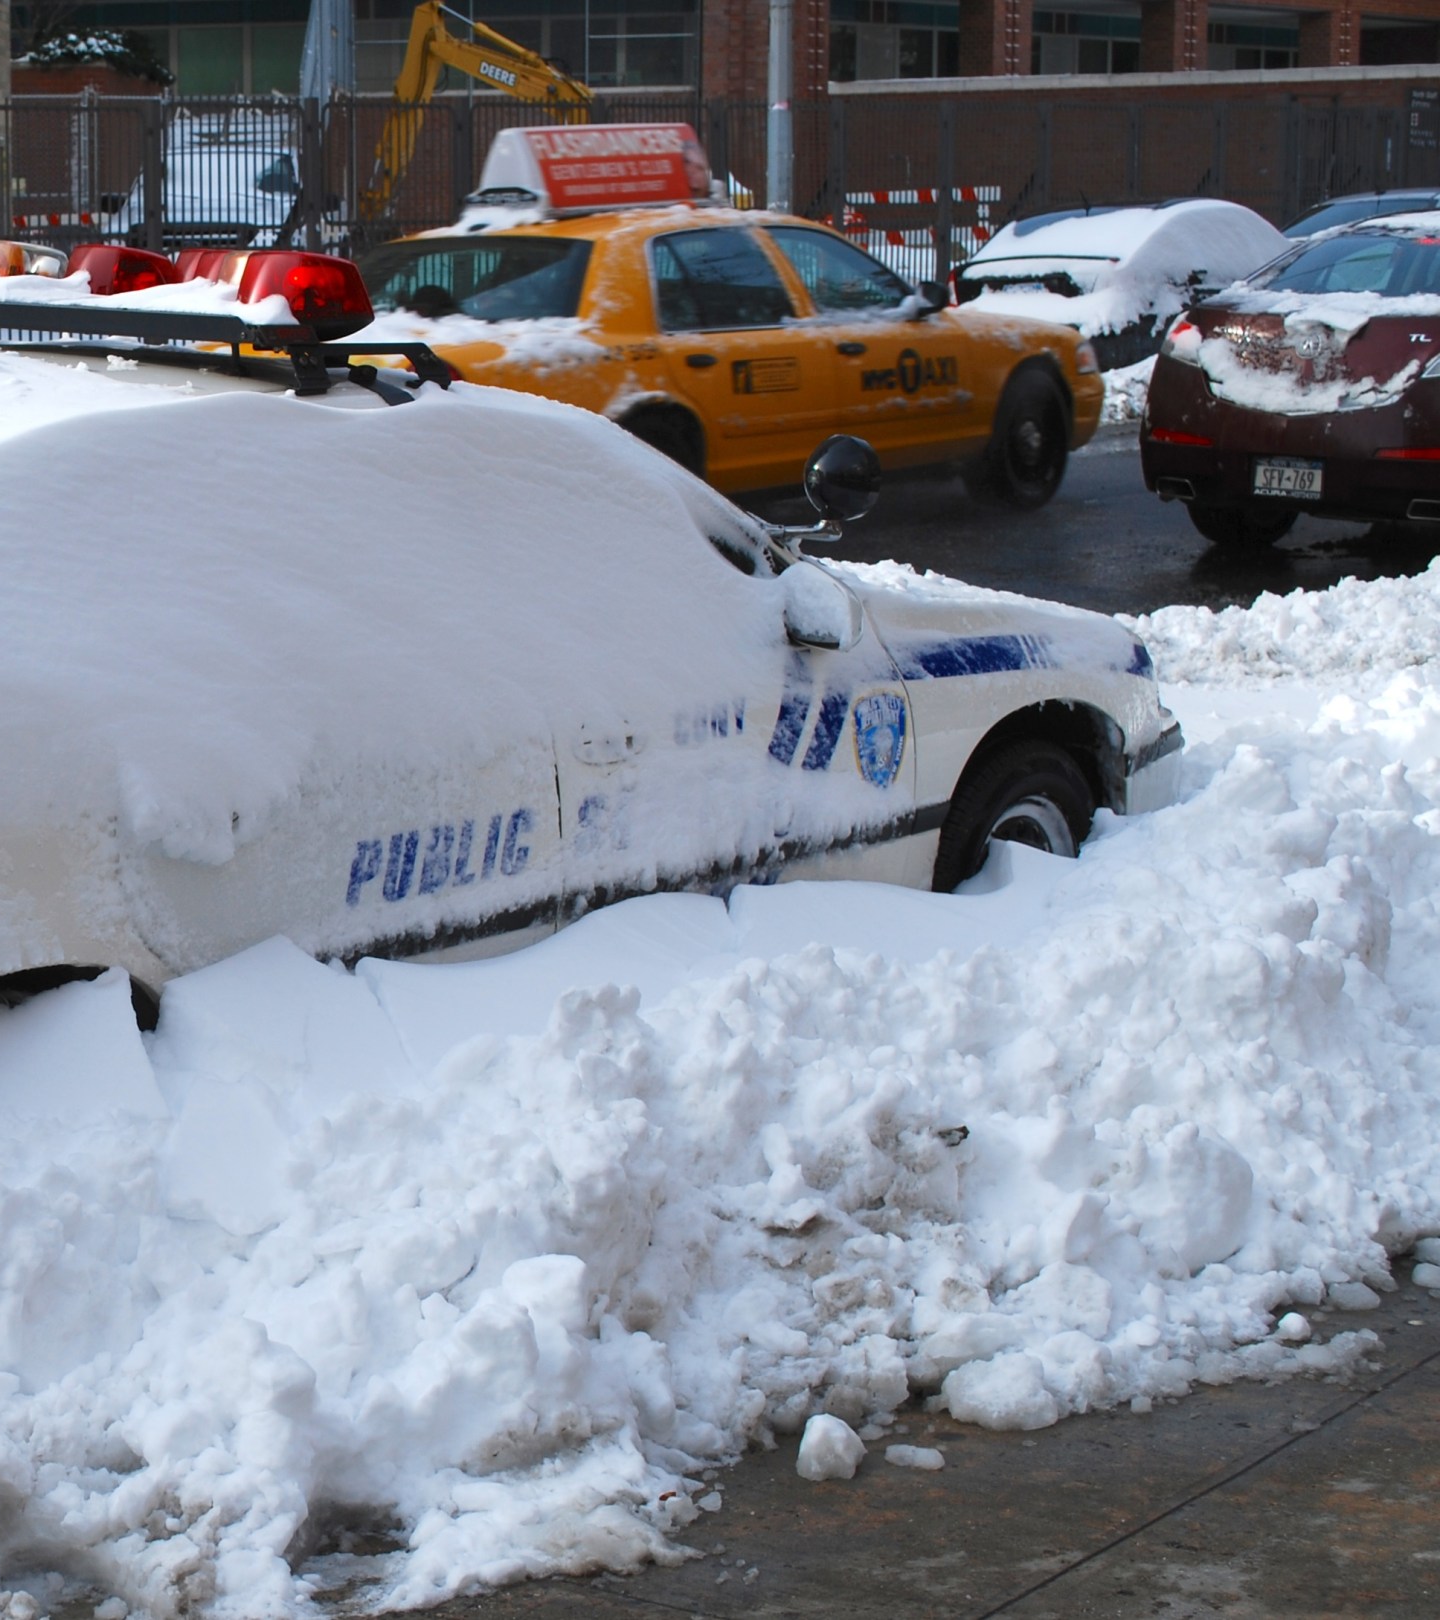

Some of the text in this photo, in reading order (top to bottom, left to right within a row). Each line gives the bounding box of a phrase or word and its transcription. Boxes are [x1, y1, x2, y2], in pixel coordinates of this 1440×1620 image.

[480, 61, 516, 87] DEERE
[529, 129, 683, 160] FLASHDANCERS
[549, 159, 673, 180] GENTLEMEN'S CLUB
[1409, 333, 1432, 343] TL
[1254, 488, 1287, 497] ACURA
[346, 808, 533, 906] PUBLIC
